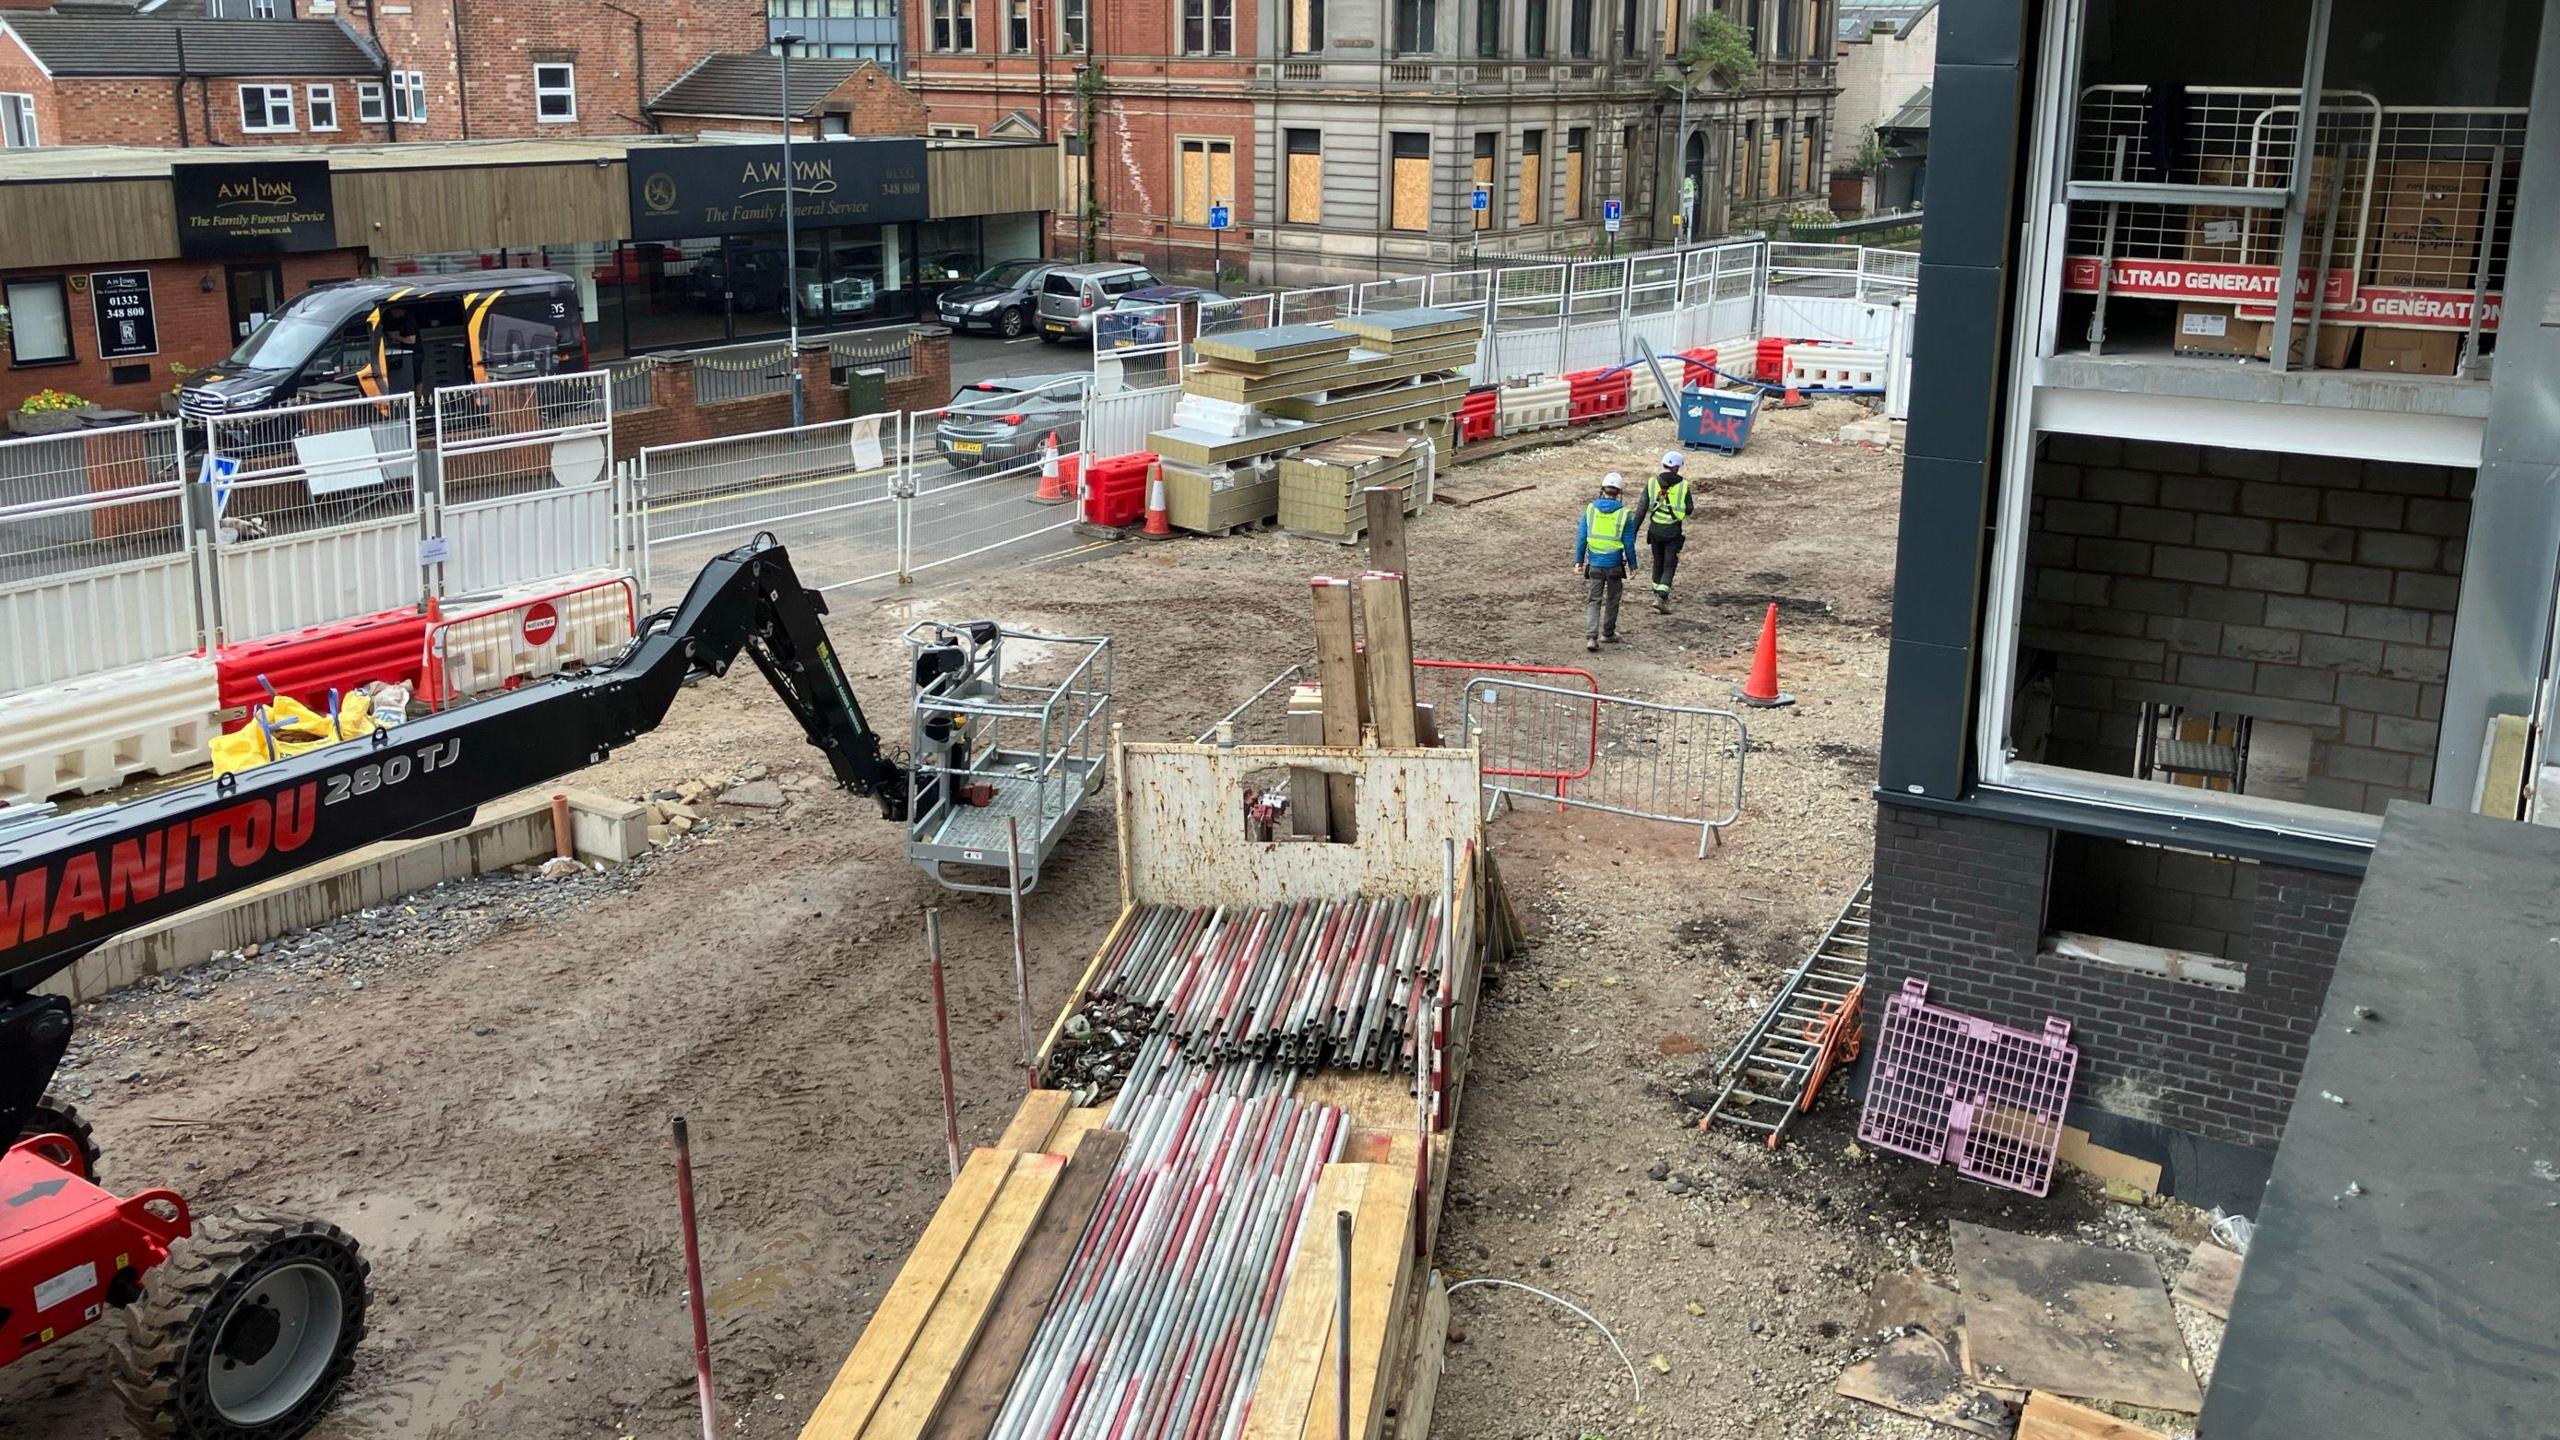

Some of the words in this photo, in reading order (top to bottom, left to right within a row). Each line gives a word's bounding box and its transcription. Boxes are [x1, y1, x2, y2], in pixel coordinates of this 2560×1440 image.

[881, 183, 900, 196] 348
[189, 216, 210, 227] The
[212, 213, 249, 229] Family
[250, 211, 290, 225] Funeral
[290, 210, 326, 222] Service
[705, 206, 728, 222] The
[732, 203, 776, 223] Family
[779, 200, 826, 218] Fneral
[828, 199, 869, 215] Service
[2108, 268, 2181, 288] ALTRAD
[2185, 271, 2309, 295] GENERATIN
[109, 295, 139, 306] 01332
[106, 308, 125, 319] 348
[126, 306, 145, 317] 800
[324, 755, 412, 806] 280
[417, 738, 461, 773] TJ
[0, 782, 317, 952] MANITOU
